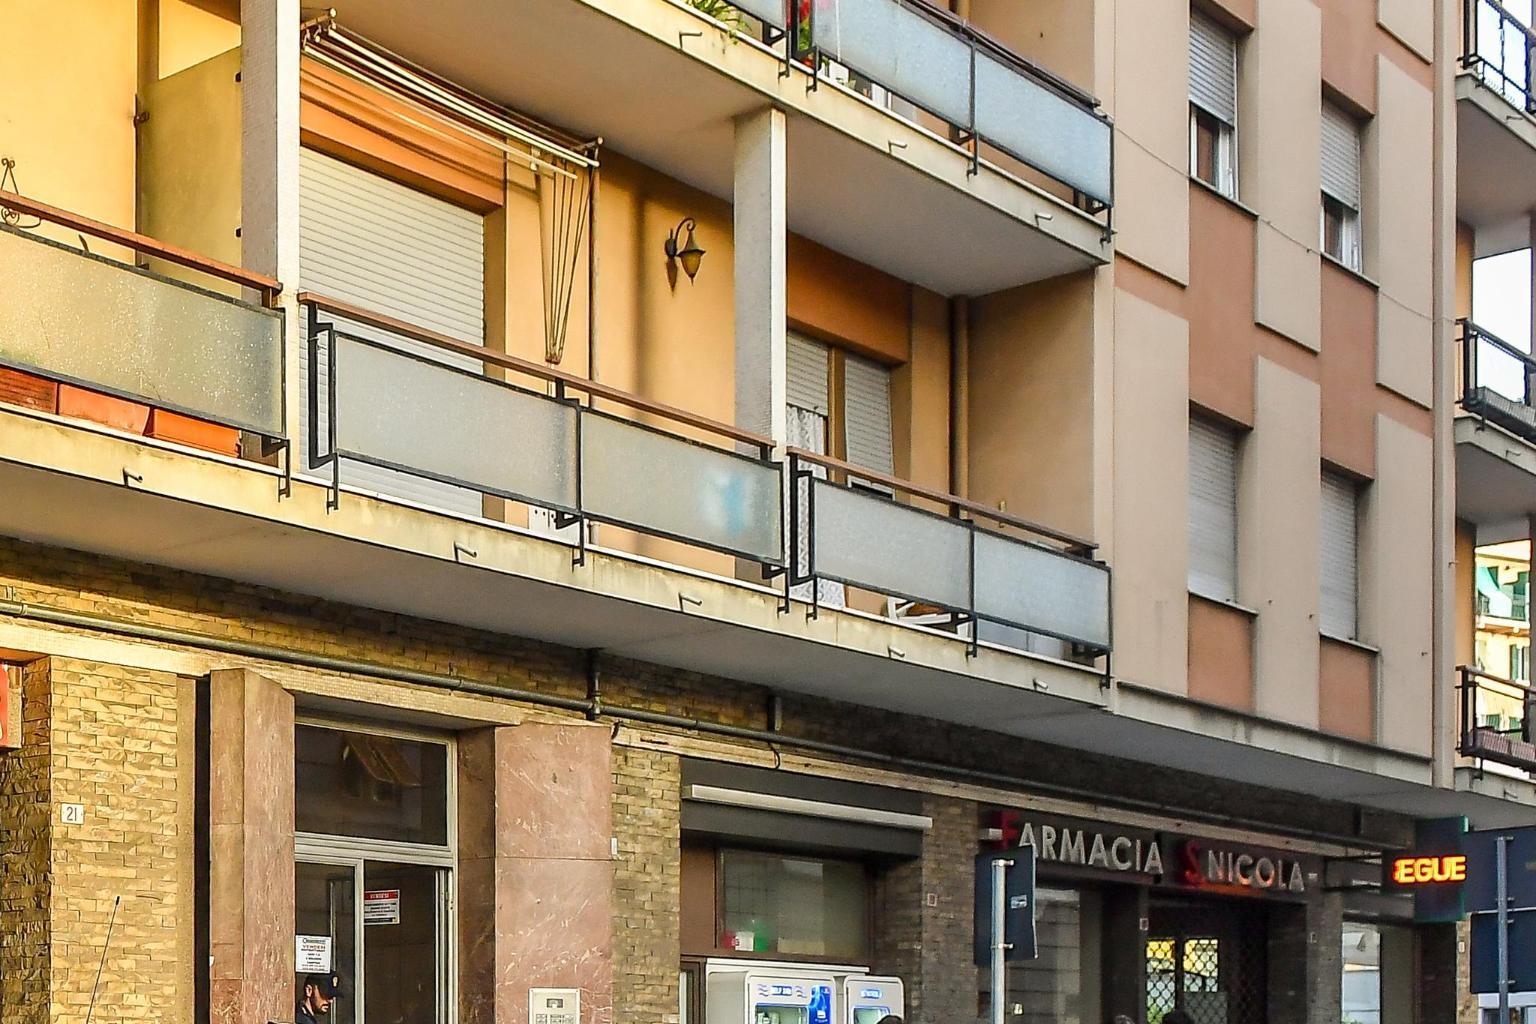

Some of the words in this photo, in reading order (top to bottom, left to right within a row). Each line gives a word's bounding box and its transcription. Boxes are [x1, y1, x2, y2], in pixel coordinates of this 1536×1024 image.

[66, 806, 78, 821] 21
[997, 810, 1164, 875] FARMACIA
[1207, 849, 1306, 893] NICOLA
